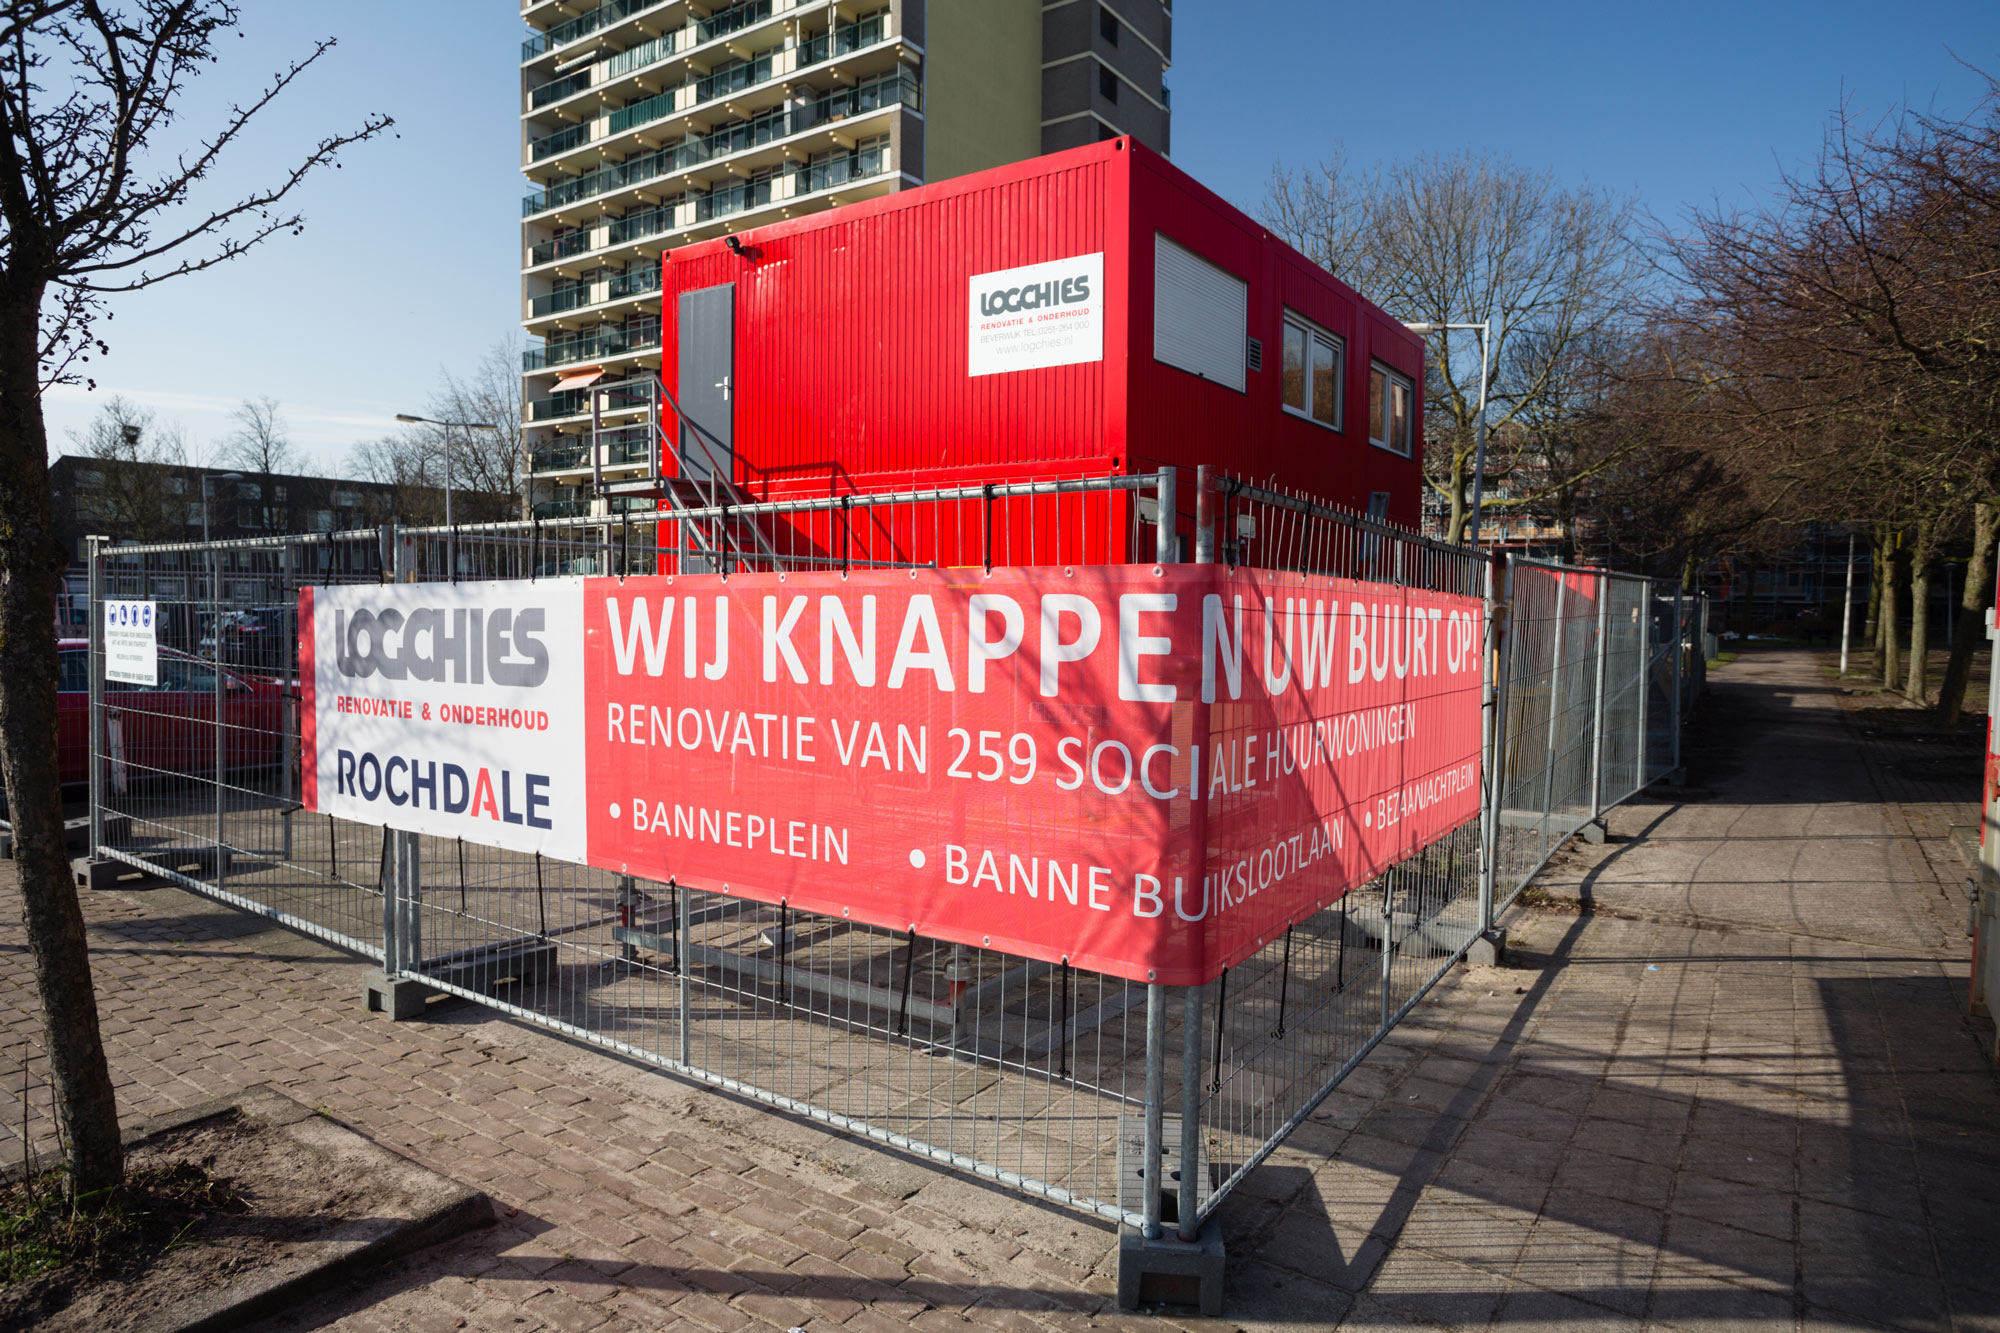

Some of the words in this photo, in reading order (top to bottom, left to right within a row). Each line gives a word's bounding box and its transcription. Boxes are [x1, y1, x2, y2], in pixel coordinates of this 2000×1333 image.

[981, 275, 1090, 316] LOGCHIES
[981, 318, 1024, 331] RENOVATIE
[1028, 316, 1034, 324] &
[1037, 308, 1090, 322] ONDERHOUD
[980, 331, 1021, 344] BEVERWIJK
[995, 335, 1073, 356] www.logchies.nl
[335, 607, 549, 688] LOGCHIES
[606, 595, 729, 680] WIJ
[763, 593, 1242, 704] KNAPPEN
[1264, 596, 1338, 695] UW
[1348, 601, 1442, 684] BUURT
[1447, 608, 1478, 674] OP!
[337, 695, 413, 719] RENOVATIE
[421, 702, 432, 721] &
[440, 703, 549, 731] ONDERHOUD
[608, 702, 816, 762] RENOVATIE
[831, 718, 927, 774] VAN
[947, 727, 1036, 784] 259
[1056, 736, 1257, 801] SOCIALE
[1266, 702, 1416, 781] HUURWONINGEN
[337, 749, 552, 830] ROCHDALE
[633, 798, 848, 865] BANNEPLEIN
[946, 844, 1112, 911] BANNE
[1133, 815, 1344, 922] BUIKSLOOTLAAN
[1377, 762, 1474, 831] BEZAANJACHTPLEIN
